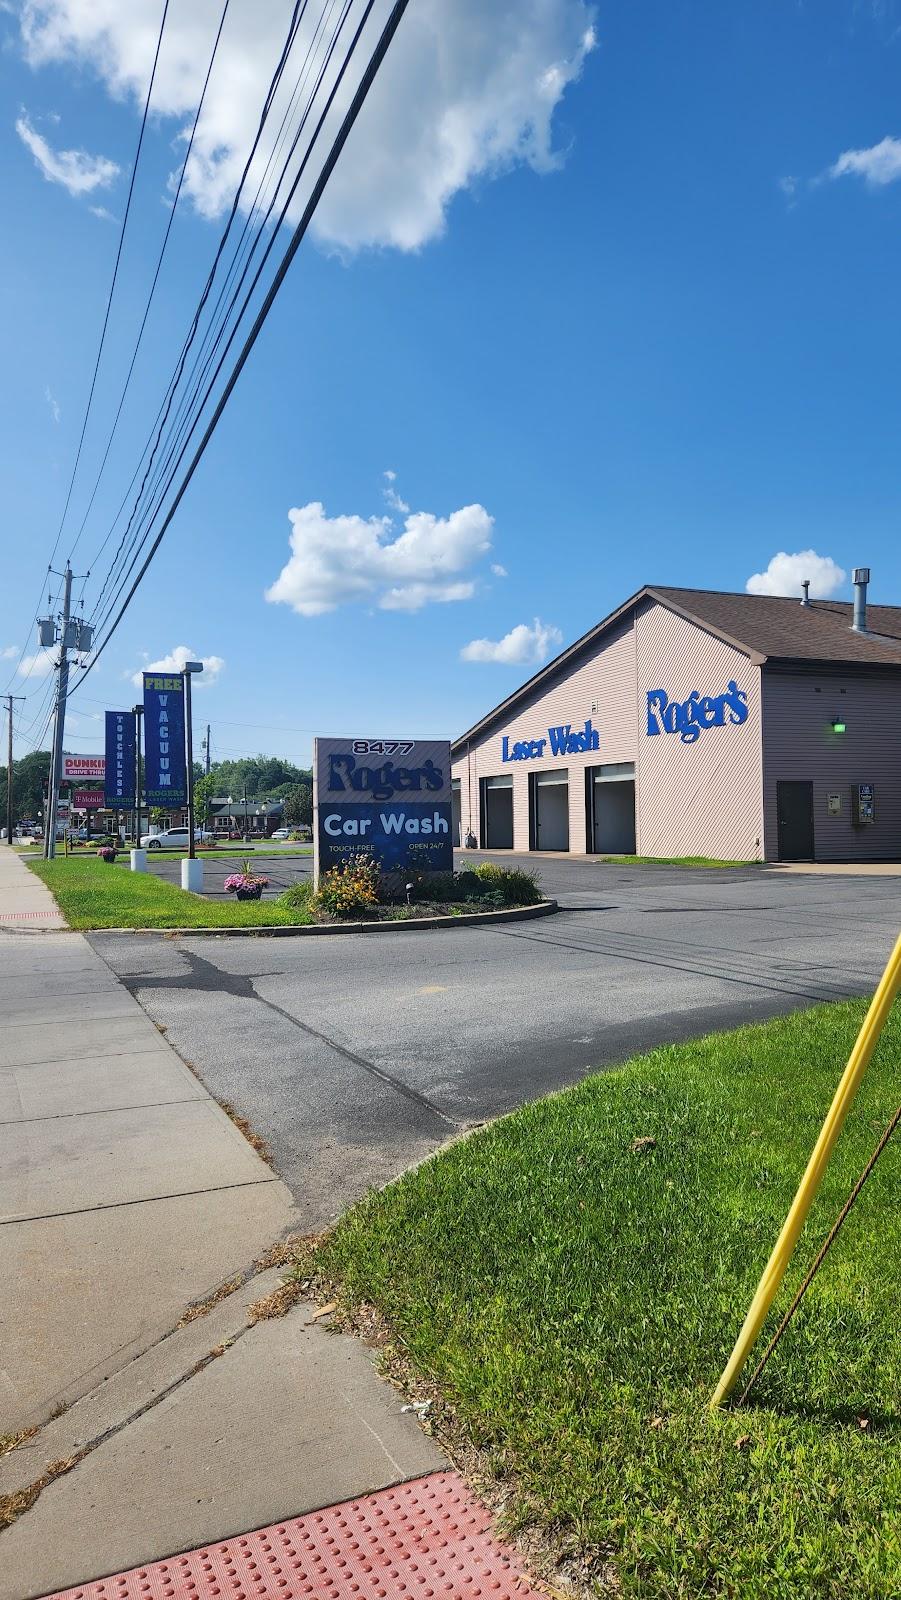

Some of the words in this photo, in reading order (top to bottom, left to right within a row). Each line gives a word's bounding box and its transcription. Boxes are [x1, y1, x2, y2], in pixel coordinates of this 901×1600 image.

[144, 677, 183, 691] FREE
[158, 694, 171, 786] VACUUM
[352, 740, 416, 756] 8477
[502, 736, 547, 763] Laser
[547, 719, 600, 757] Wash
[116, 715, 124, 796] TOUCHLESS
[323, 813, 372, 837] Car
[379, 811, 449, 835] Wash
[329, 844, 376, 853] TOUCH-FREE
[429, 842, 444, 850] 24/7
